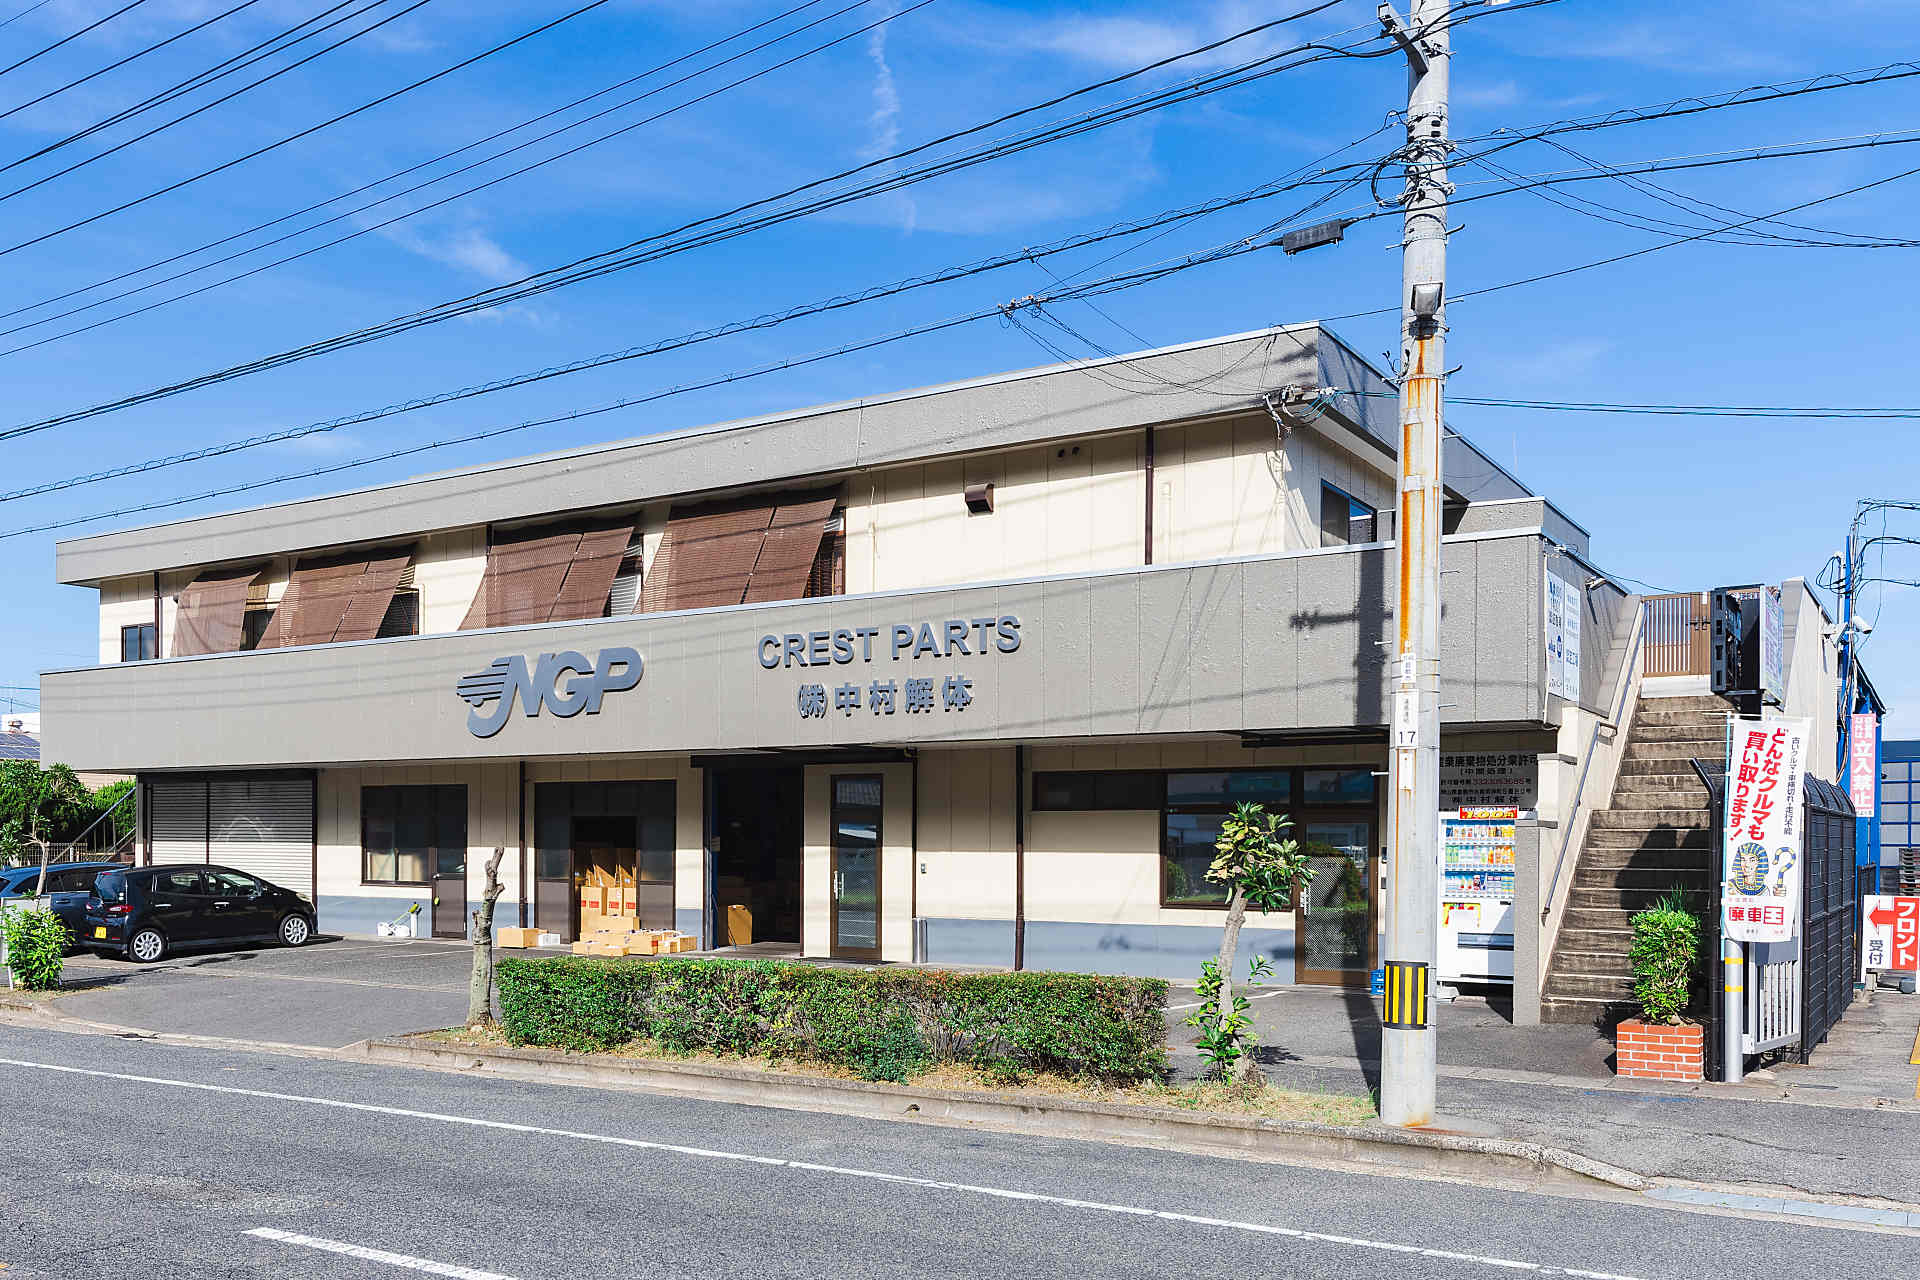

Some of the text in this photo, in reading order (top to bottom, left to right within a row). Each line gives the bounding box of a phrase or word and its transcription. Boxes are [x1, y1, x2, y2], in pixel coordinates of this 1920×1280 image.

[758, 615, 1022, 670] CREST PARTS
[460, 646, 643, 739] NGP
[1399, 731, 1416, 744] 17
[1747, 727, 1789, 841] どんなクルマも
[1853, 740, 1873, 808] 立入禁止
[1728, 906, 1785, 926] 廃車王
[1896, 901, 1916, 966] フロント
[1868, 939, 1883, 965] 受付
